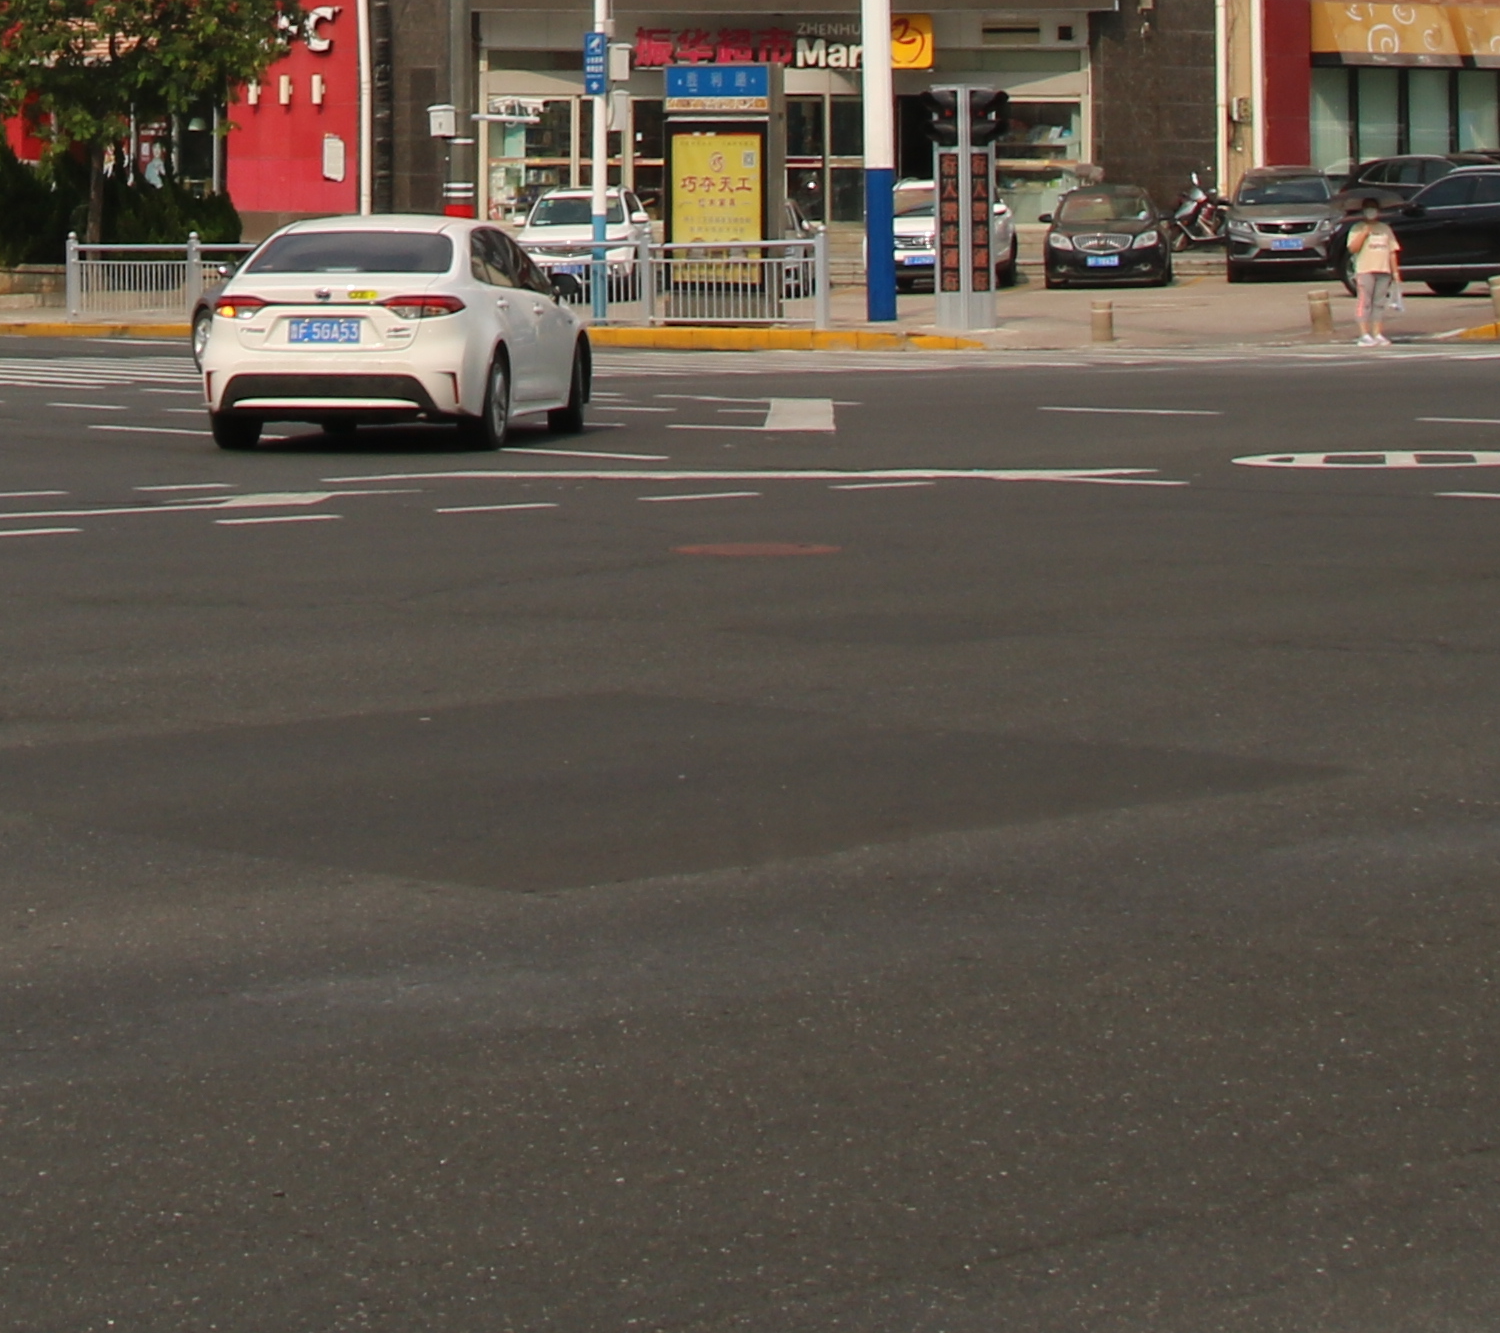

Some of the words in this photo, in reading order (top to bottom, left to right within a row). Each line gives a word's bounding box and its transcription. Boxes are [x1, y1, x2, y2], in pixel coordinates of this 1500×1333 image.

[796, 21, 862, 36] ZHENHU
[634, 26, 794, 66] 振华超市
[795, 37, 864, 69] Mar
[680, 175, 753, 194] 巧夺天工
